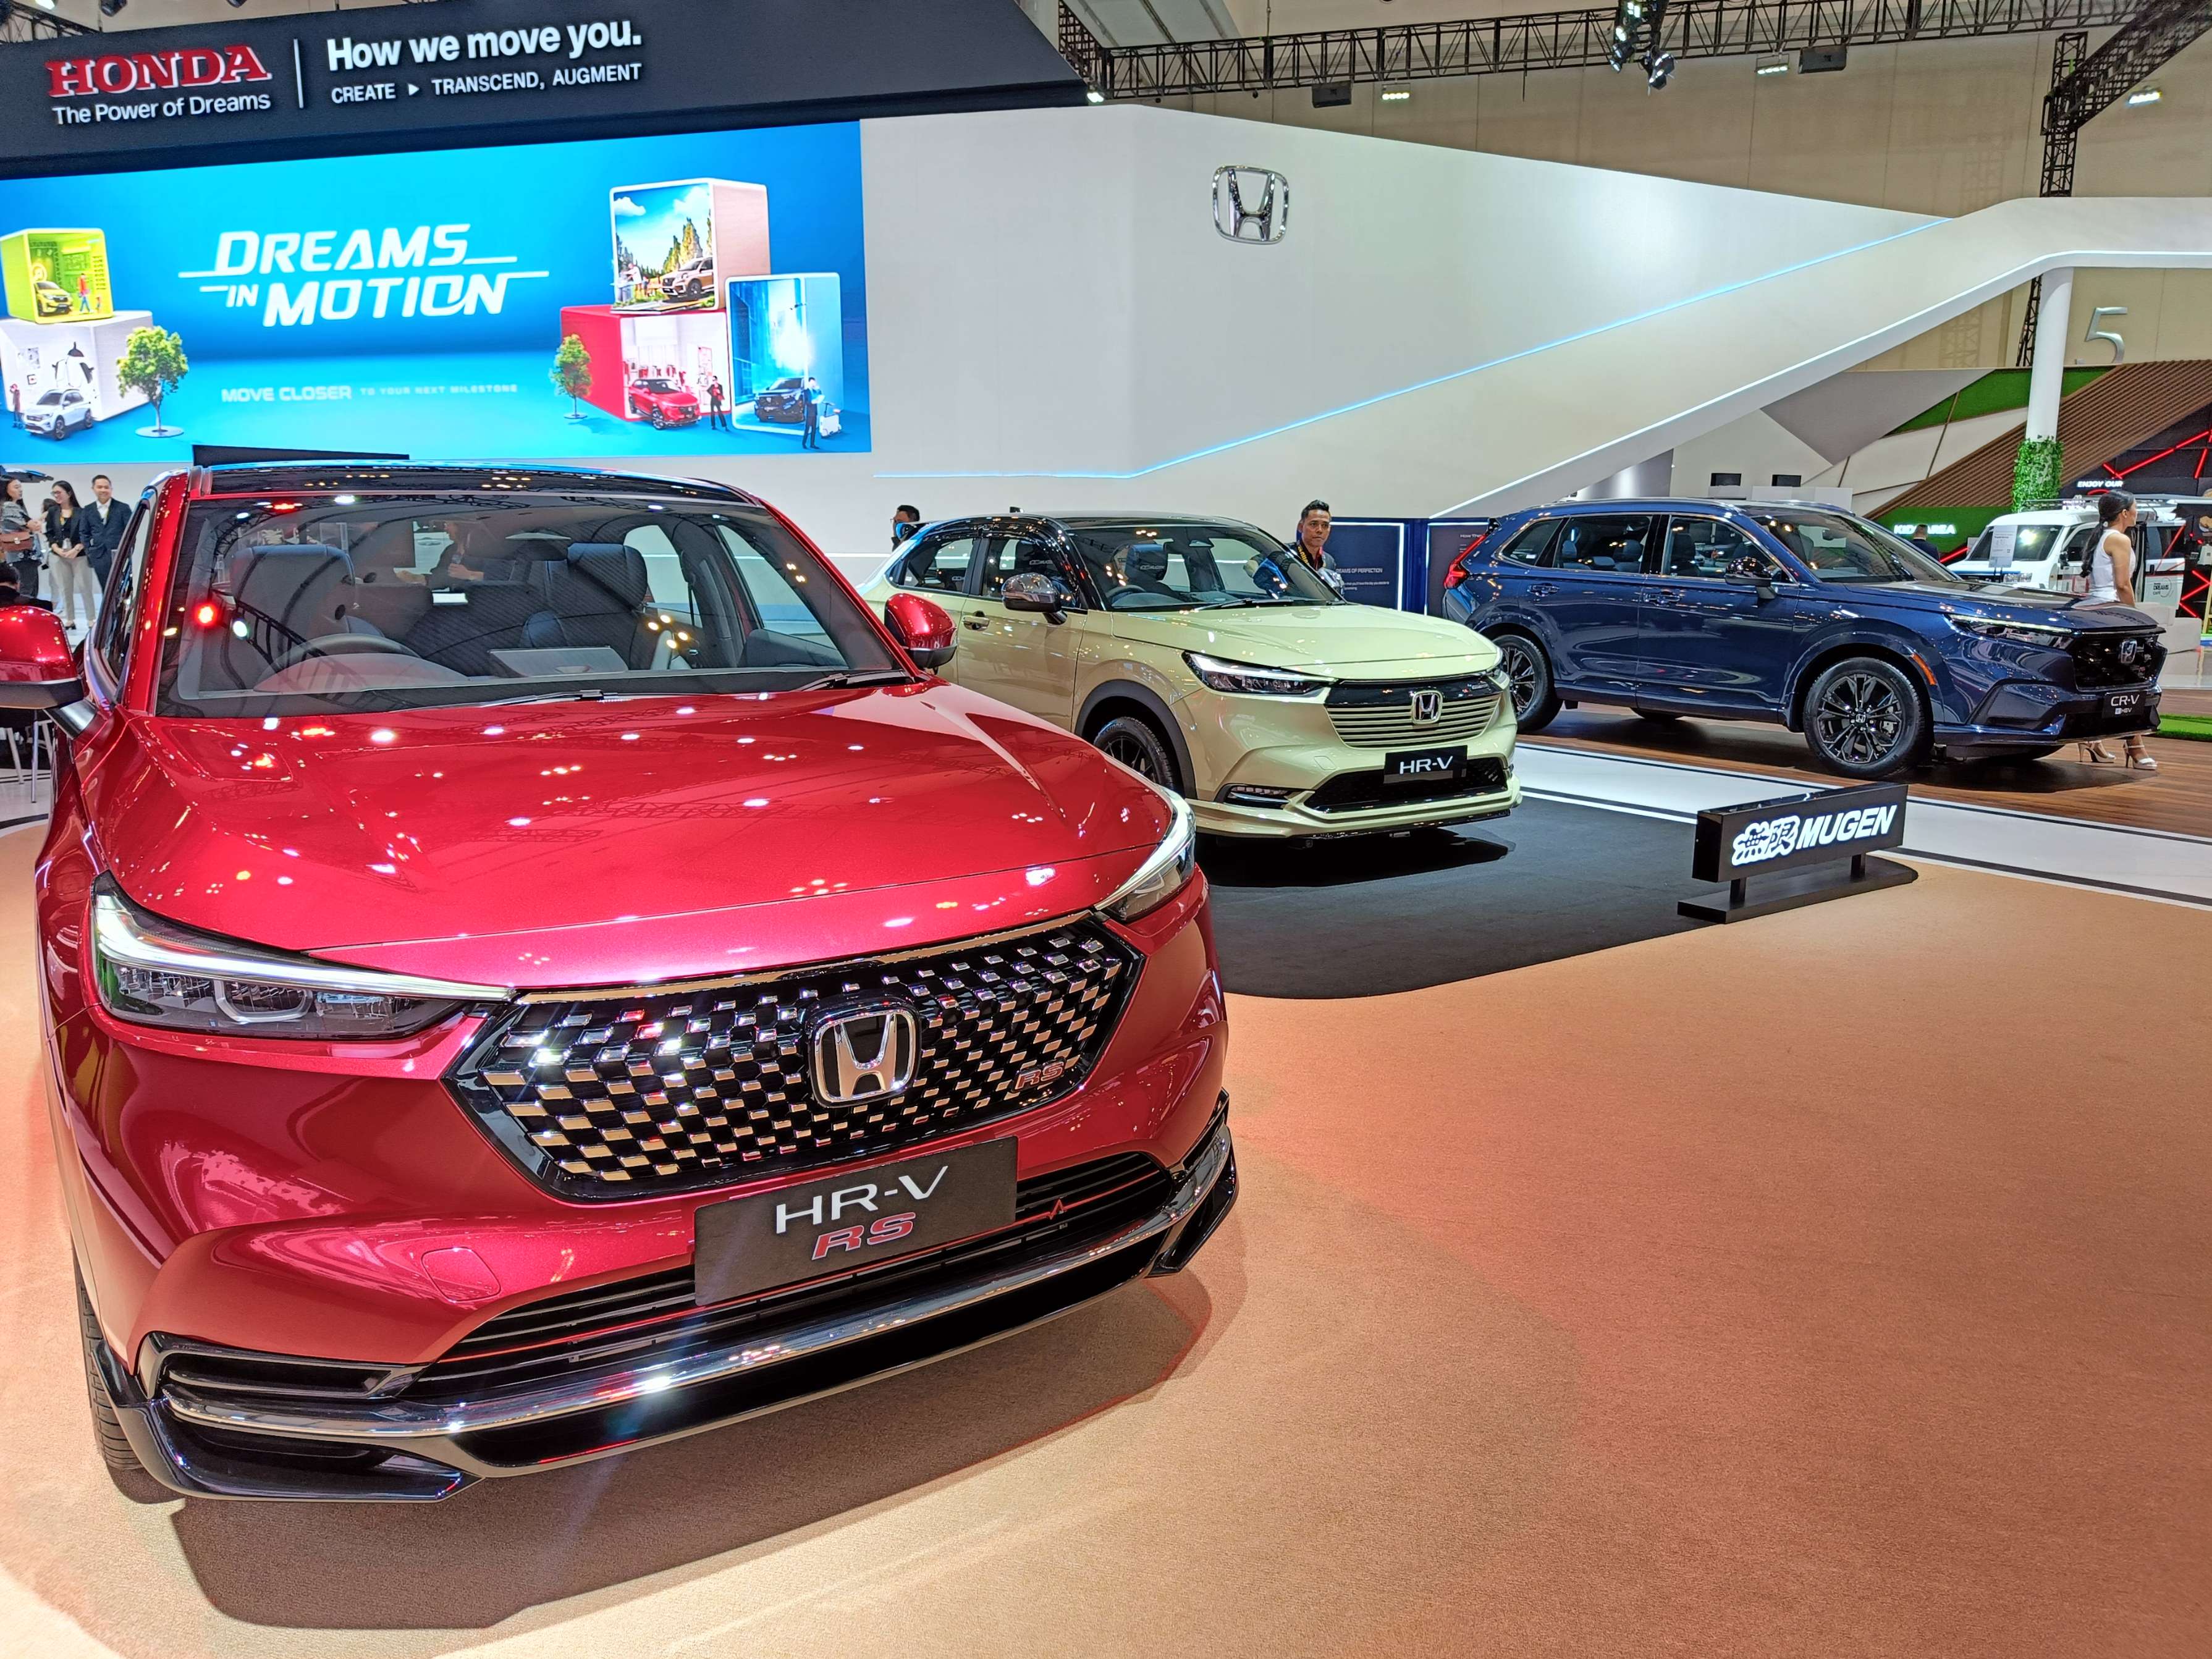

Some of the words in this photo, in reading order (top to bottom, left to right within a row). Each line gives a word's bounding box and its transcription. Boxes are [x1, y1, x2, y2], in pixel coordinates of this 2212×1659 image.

[327, 38, 401, 71] How
[408, 36, 460, 62] we
[468, 29, 560, 58] move
[567, 21, 642, 59] you.
[45, 45, 272, 97] HONDA
[331, 83, 395, 103] CREATE
[432, 70, 544, 95] TRANSCEND,
[552, 63, 642, 85] AUGMENT
[53, 106, 92, 125] The
[95, 103, 159, 122] Power
[163, 97, 184, 116] of
[189, 94, 272, 116] Dreams
[213, 224, 471, 275] DREAMS
[226, 284, 259, 308] IN
[262, 272, 510, 327] MOTION
[2075, 306, 2129, 365] 5
[221, 387, 276, 403] MOVE
[279, 386, 353, 402] CLOSER
[360, 387, 376, 395] TO
[380, 387, 411, 395] YOUR
[415, 386, 445, 394] NEXT
[450, 384, 518, 394] MILESTONE
[1893, 524, 1917, 534] KID
[2111, 694, 2140, 707] CR-V
[1399, 756, 1453, 775] HR-V
[1796, 804, 1898, 850] MUGEN
[1015, 1062, 1064, 1090] RS
[776, 1165, 949, 1235] HR-V
[811, 1212, 916, 1261] RS
